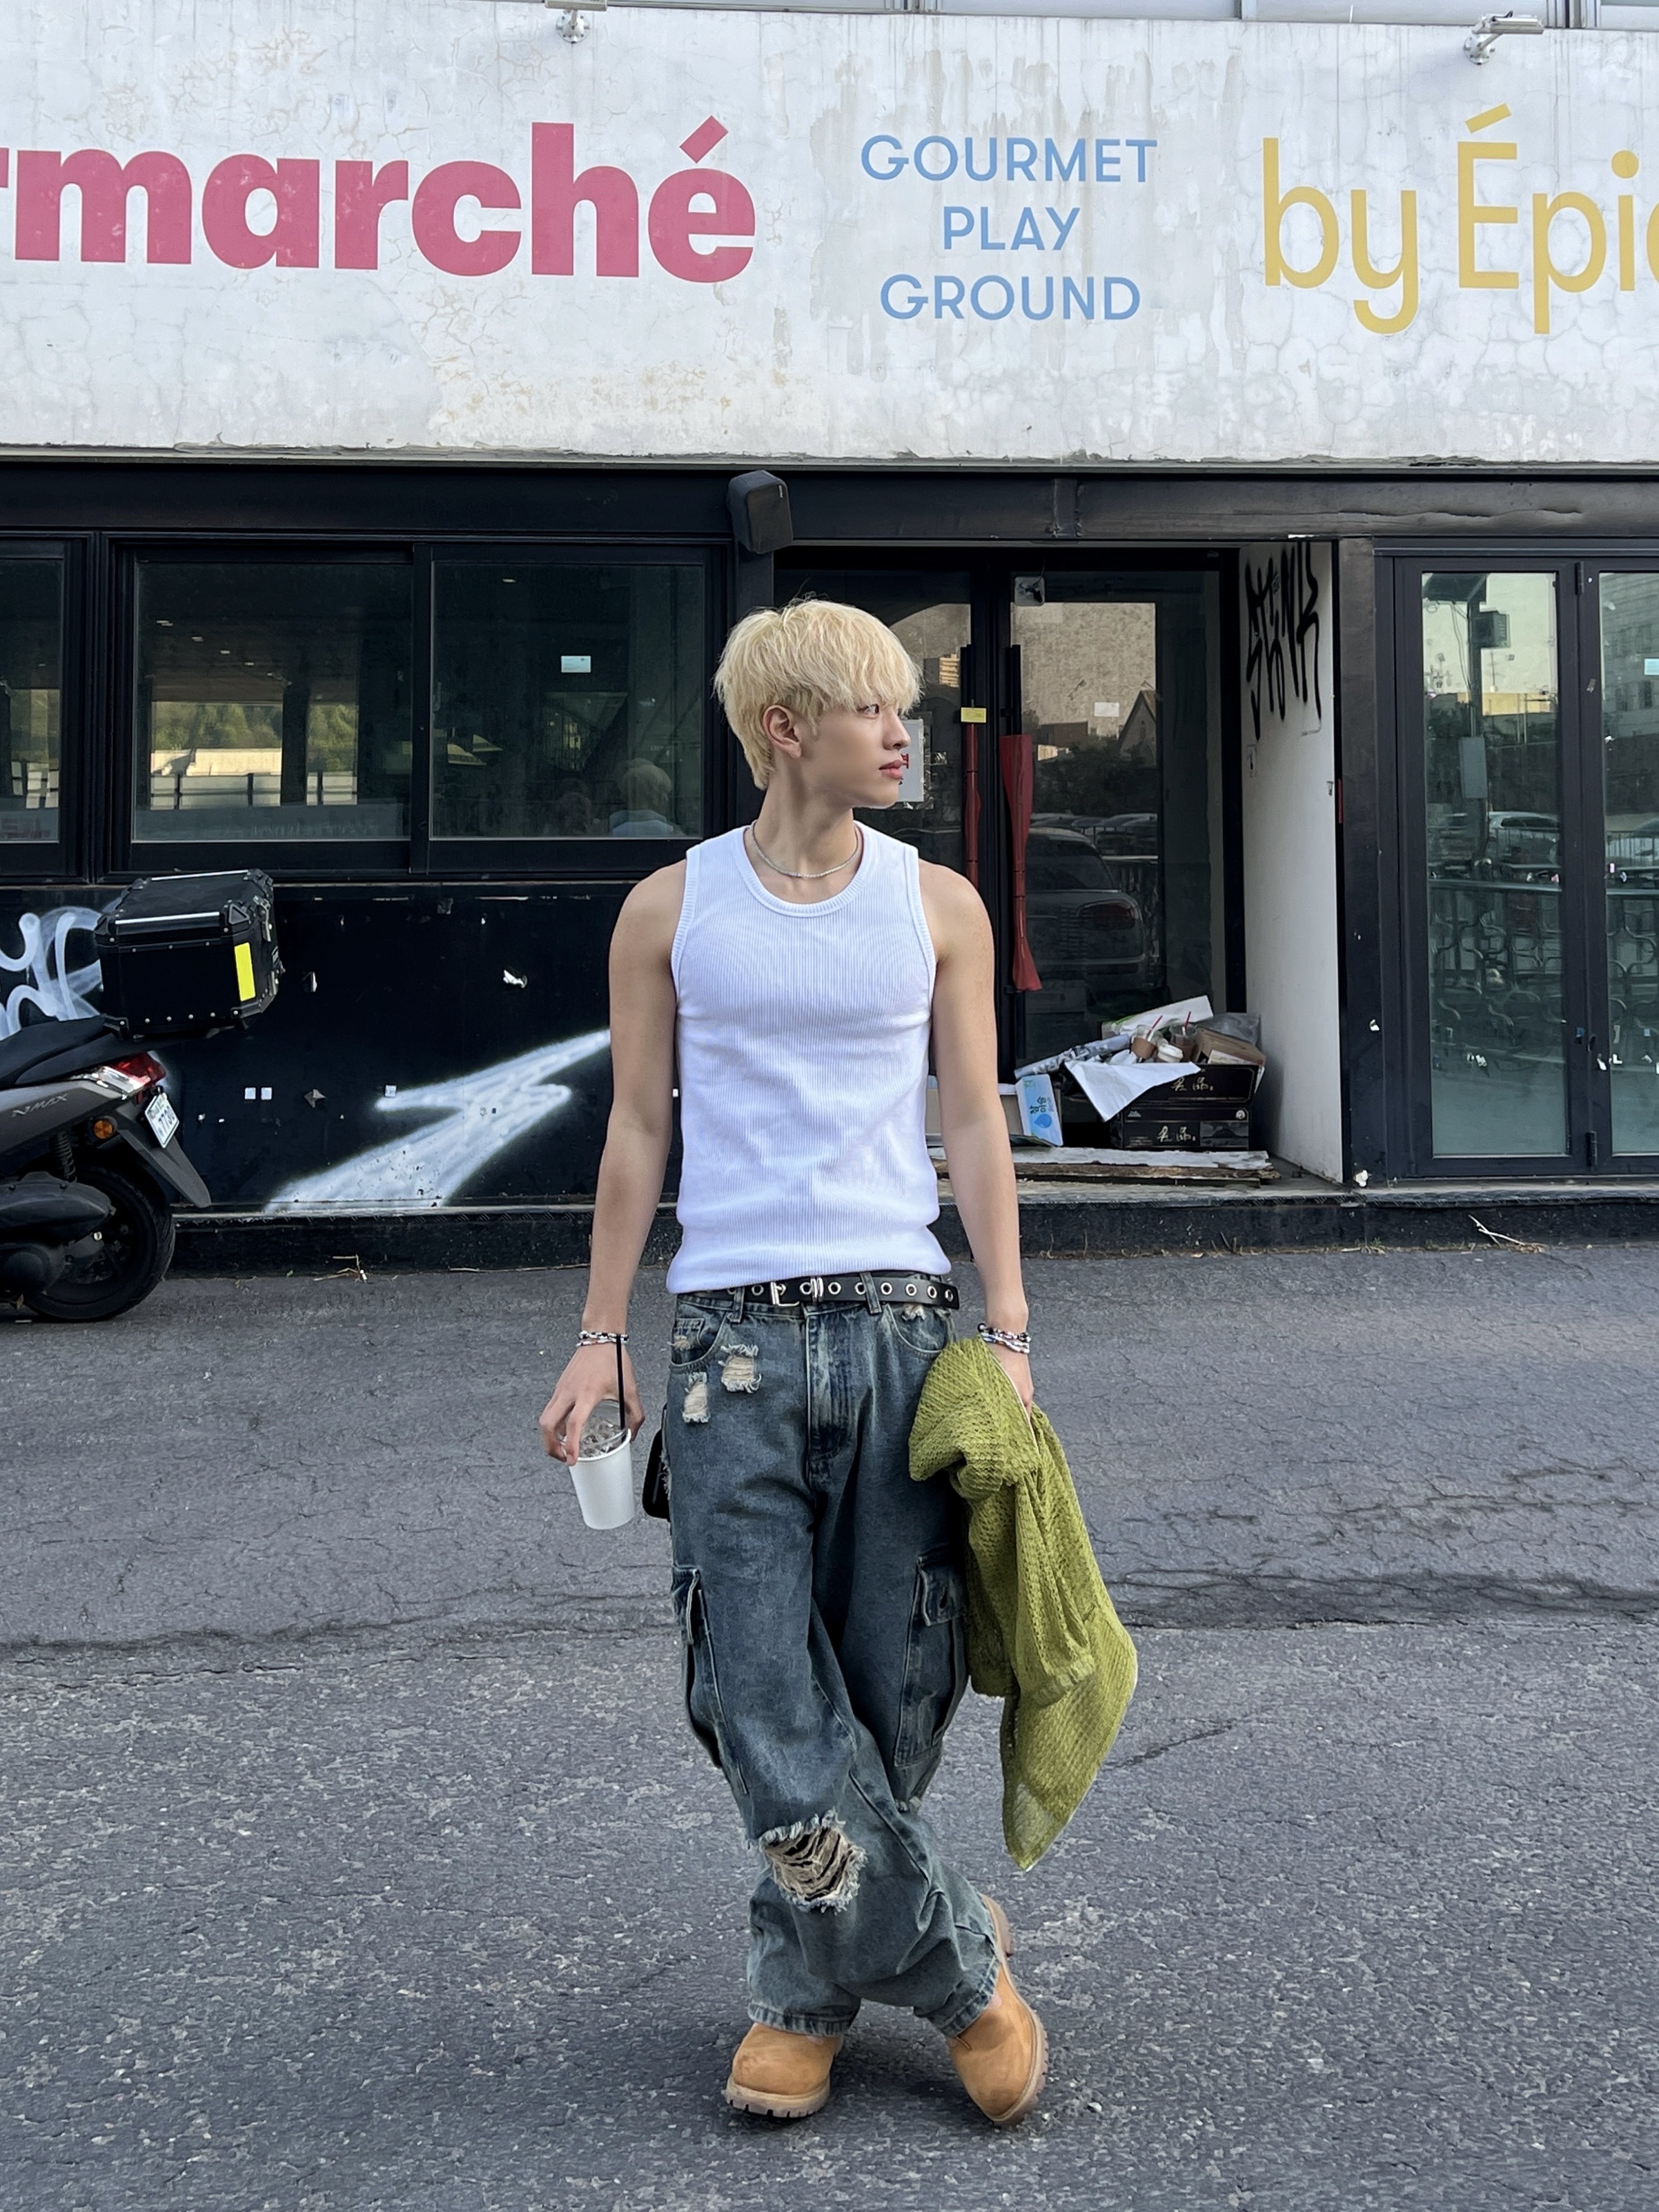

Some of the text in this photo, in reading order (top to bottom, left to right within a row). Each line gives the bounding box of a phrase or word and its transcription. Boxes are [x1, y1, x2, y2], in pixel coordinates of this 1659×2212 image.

[861, 134, 1157, 183] GOURMET
[0, 115, 756, 283] marché
[1263, 104, 1659, 334] by Épi
[942, 205, 1080, 251] PLAY
[879, 273, 1141, 320] GROUND
[11, 1093, 68, 1117] NMAX
